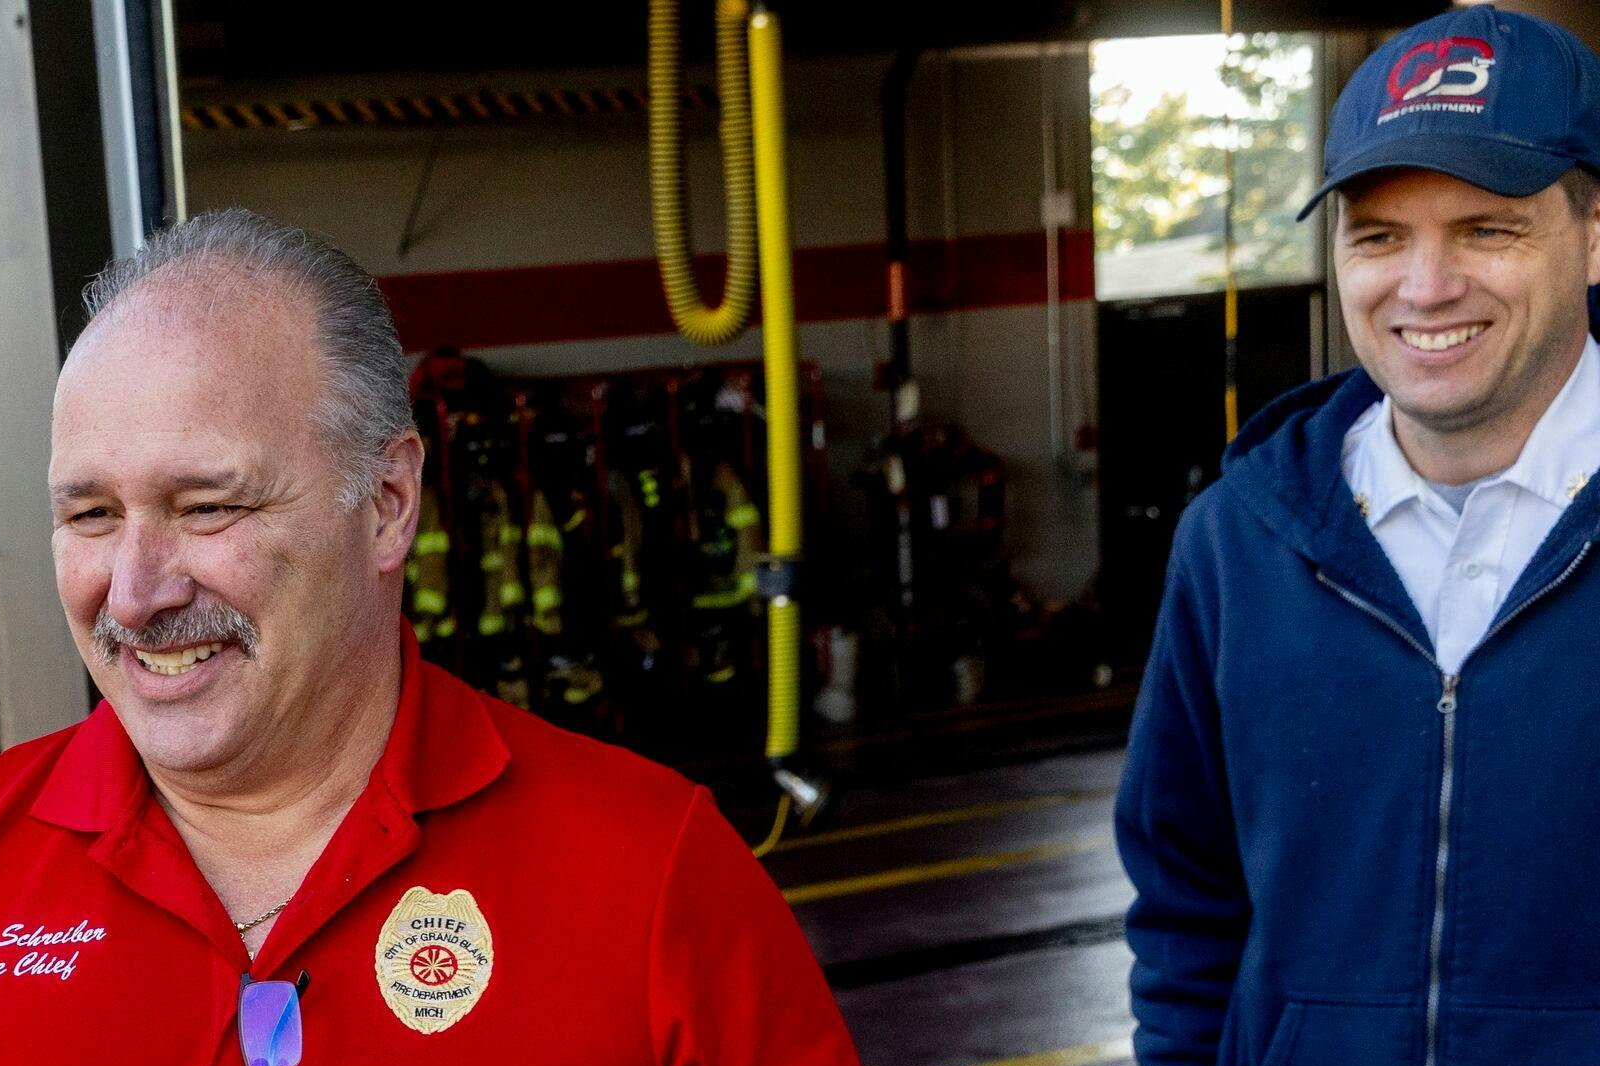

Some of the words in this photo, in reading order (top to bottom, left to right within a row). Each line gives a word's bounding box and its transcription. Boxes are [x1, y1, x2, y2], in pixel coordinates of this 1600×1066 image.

[411, 917, 466, 933] CHIEF
[385, 942, 404, 960] CITY
[405, 934, 419, 947] OF
[420, 932, 459, 944] GRAND
[459, 937, 488, 966] BLANC
[13, 951, 80, 981] Chief
[390, 981, 412, 996] FIRE
[412, 986, 472, 1000] DEPARTMENT
[414, 1007, 444, 1018] MICH
